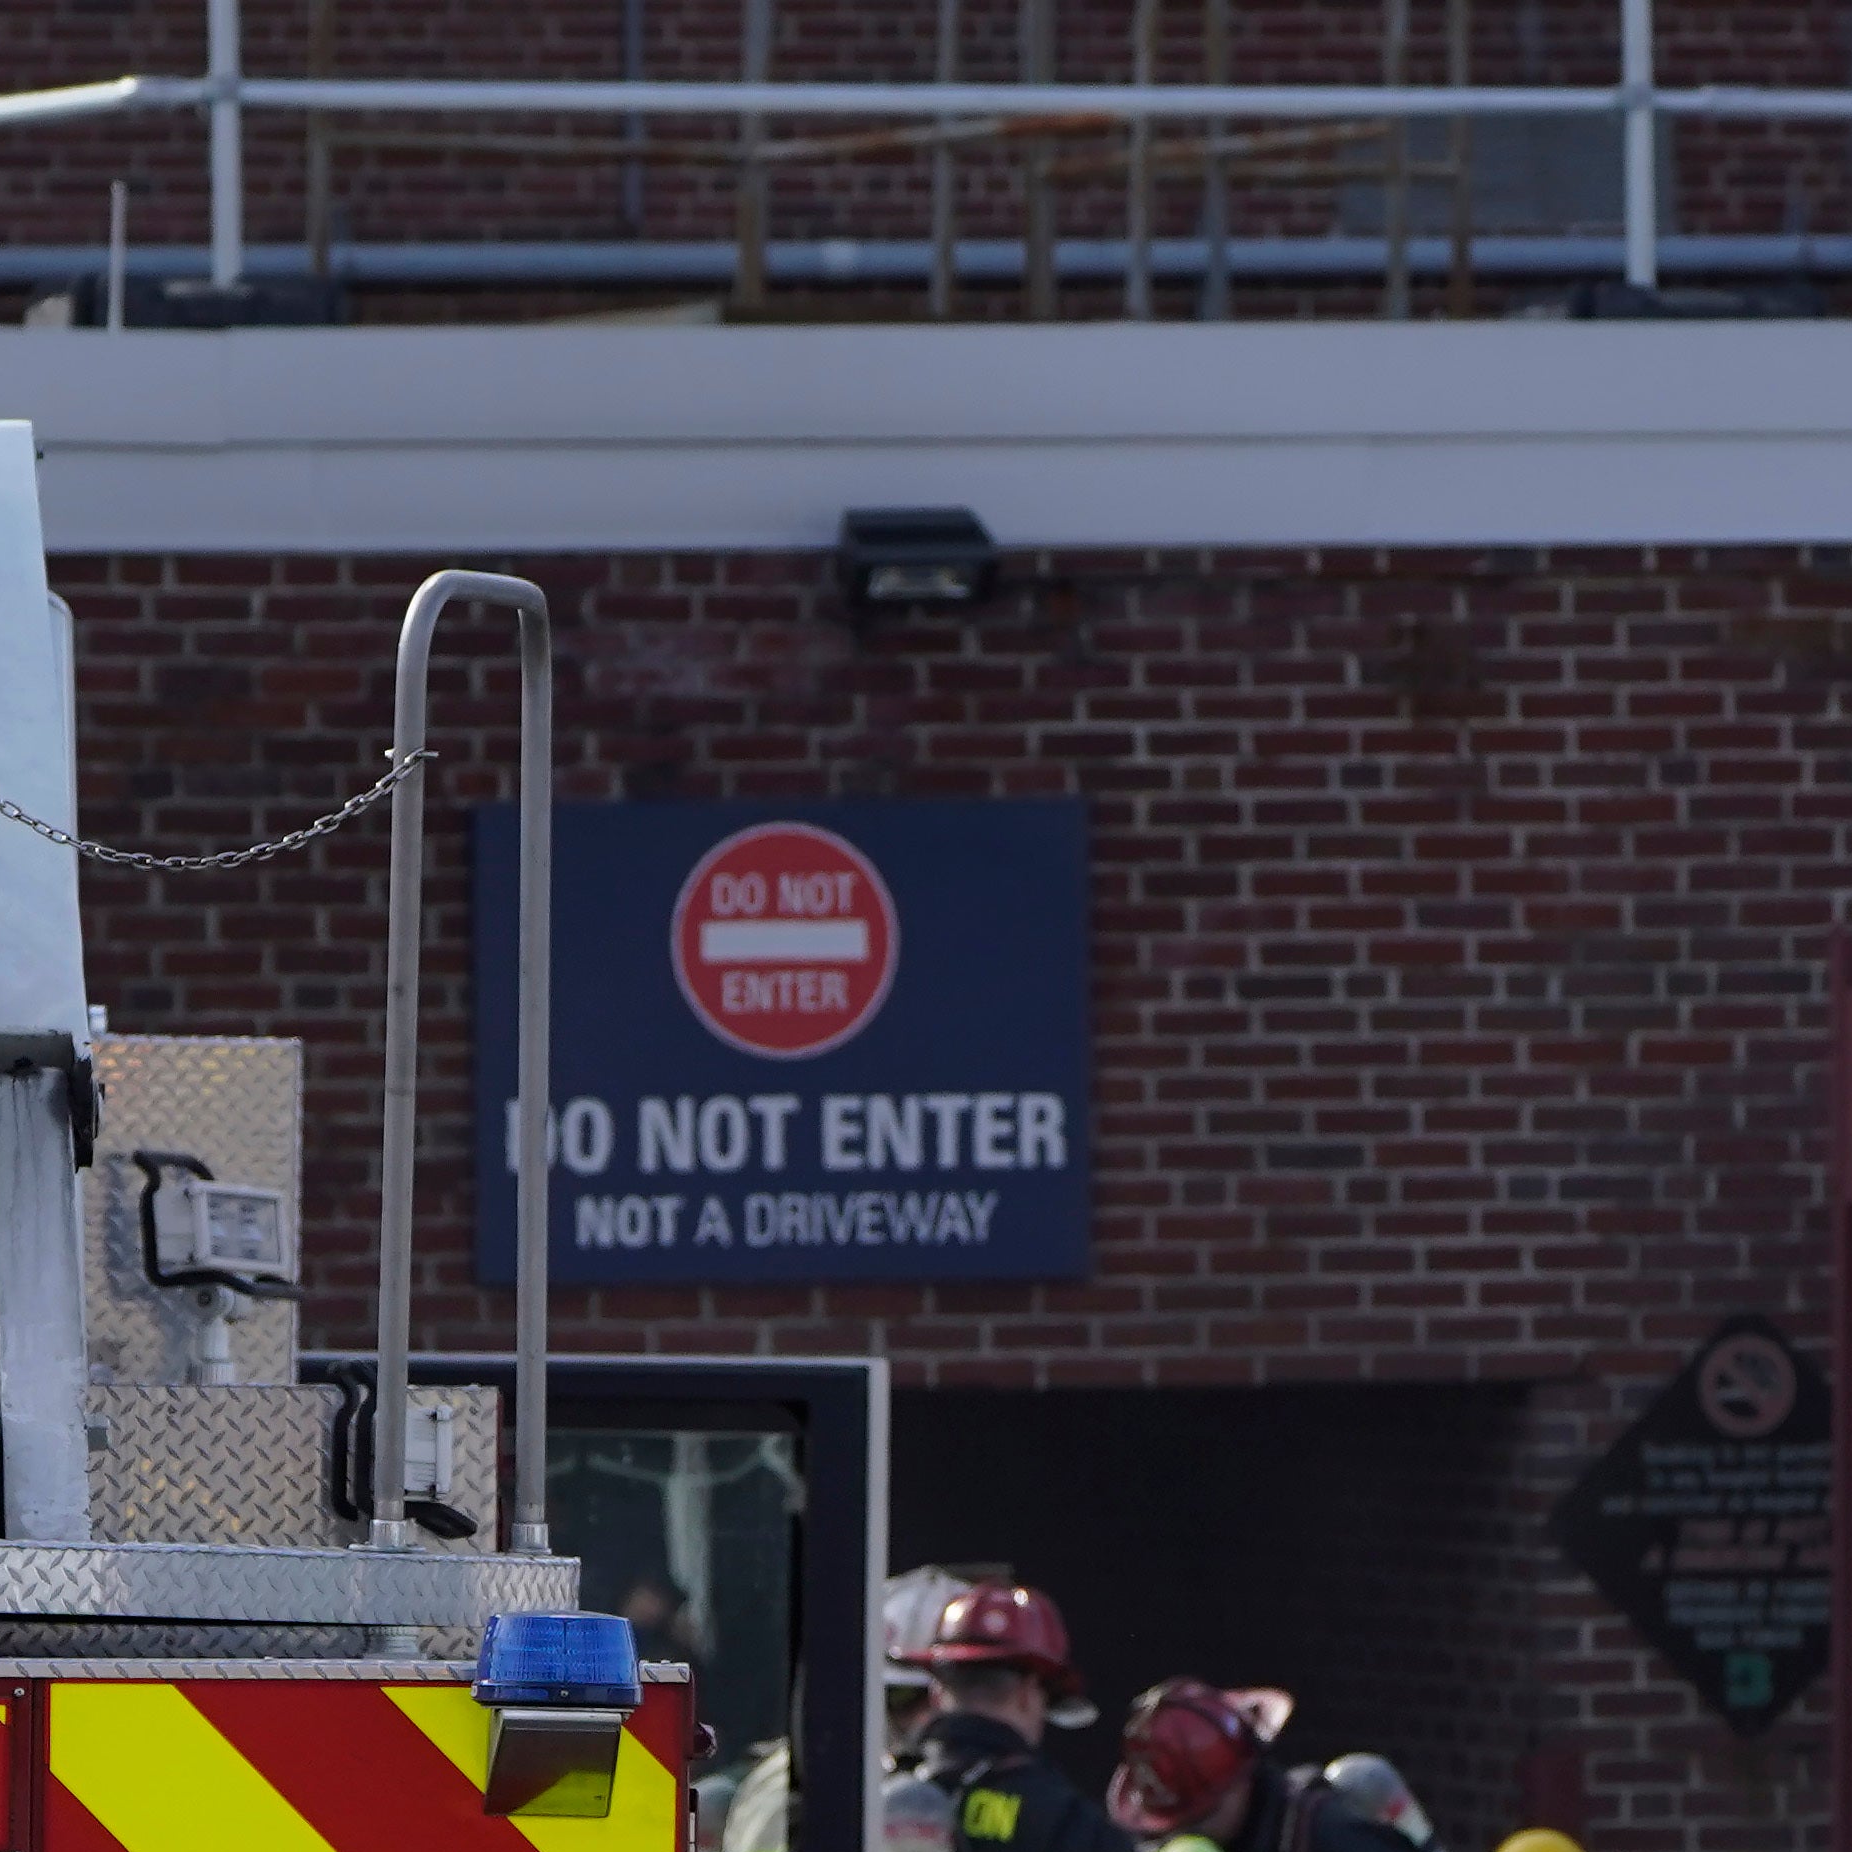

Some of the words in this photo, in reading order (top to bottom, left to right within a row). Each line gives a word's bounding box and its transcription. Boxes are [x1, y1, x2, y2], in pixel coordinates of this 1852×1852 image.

[711, 873, 766, 915] DO
[777, 871, 857, 915] NOT
[720, 970, 849, 1015] ENTER
[638, 1094, 801, 1175] NOT
[820, 1092, 1070, 1173] ENTER
[574, 1193, 683, 1250] NOT
[692, 1196, 734, 1249] A
[743, 1191, 999, 1250] DRIVEWAY
